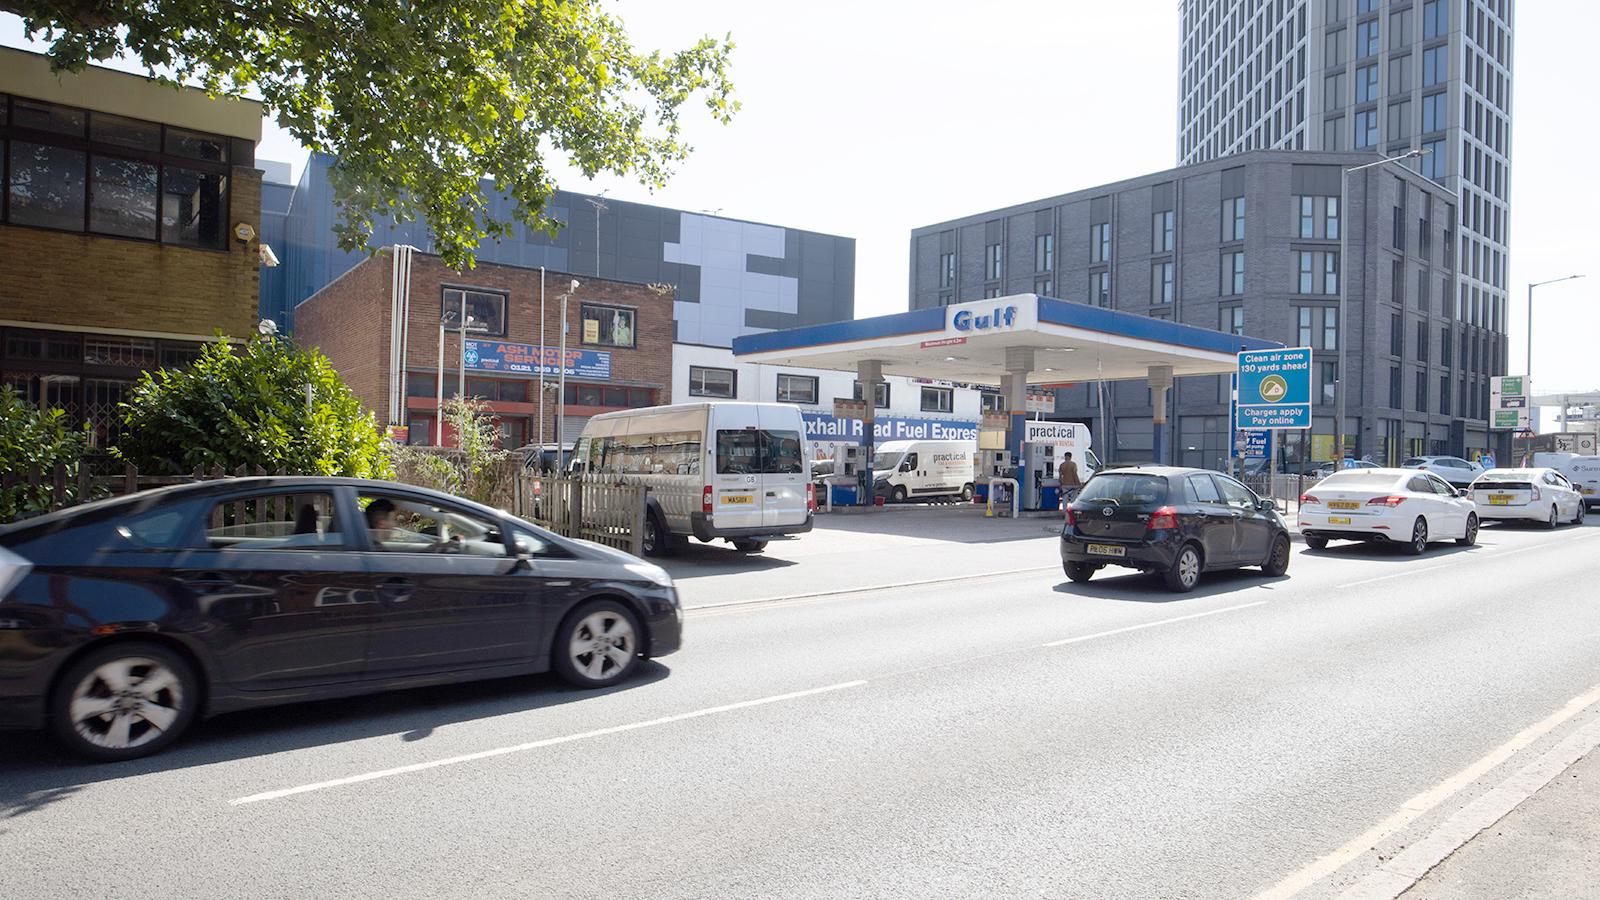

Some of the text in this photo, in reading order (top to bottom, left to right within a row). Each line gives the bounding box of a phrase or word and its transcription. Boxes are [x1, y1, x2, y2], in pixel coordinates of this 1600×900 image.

[953, 306, 1017, 331] Gulf
[496, 344, 583, 360] ASH MOTOR
[1245, 355, 1269, 363] Clean
[1284, 353, 1304, 361] zone
[510, 364, 532, 373] 0121
[534, 366, 551, 374] 39
[1241, 362, 1308, 373] 130 yards ahead
[1245, 408, 1304, 417] Charges apply
[1252, 417, 1294, 426] Pay online
[852, 418, 891, 438] Rad
[896, 421, 927, 438] Fuel
[1030, 426, 1075, 440] practical
[933, 452, 966, 463] practical
